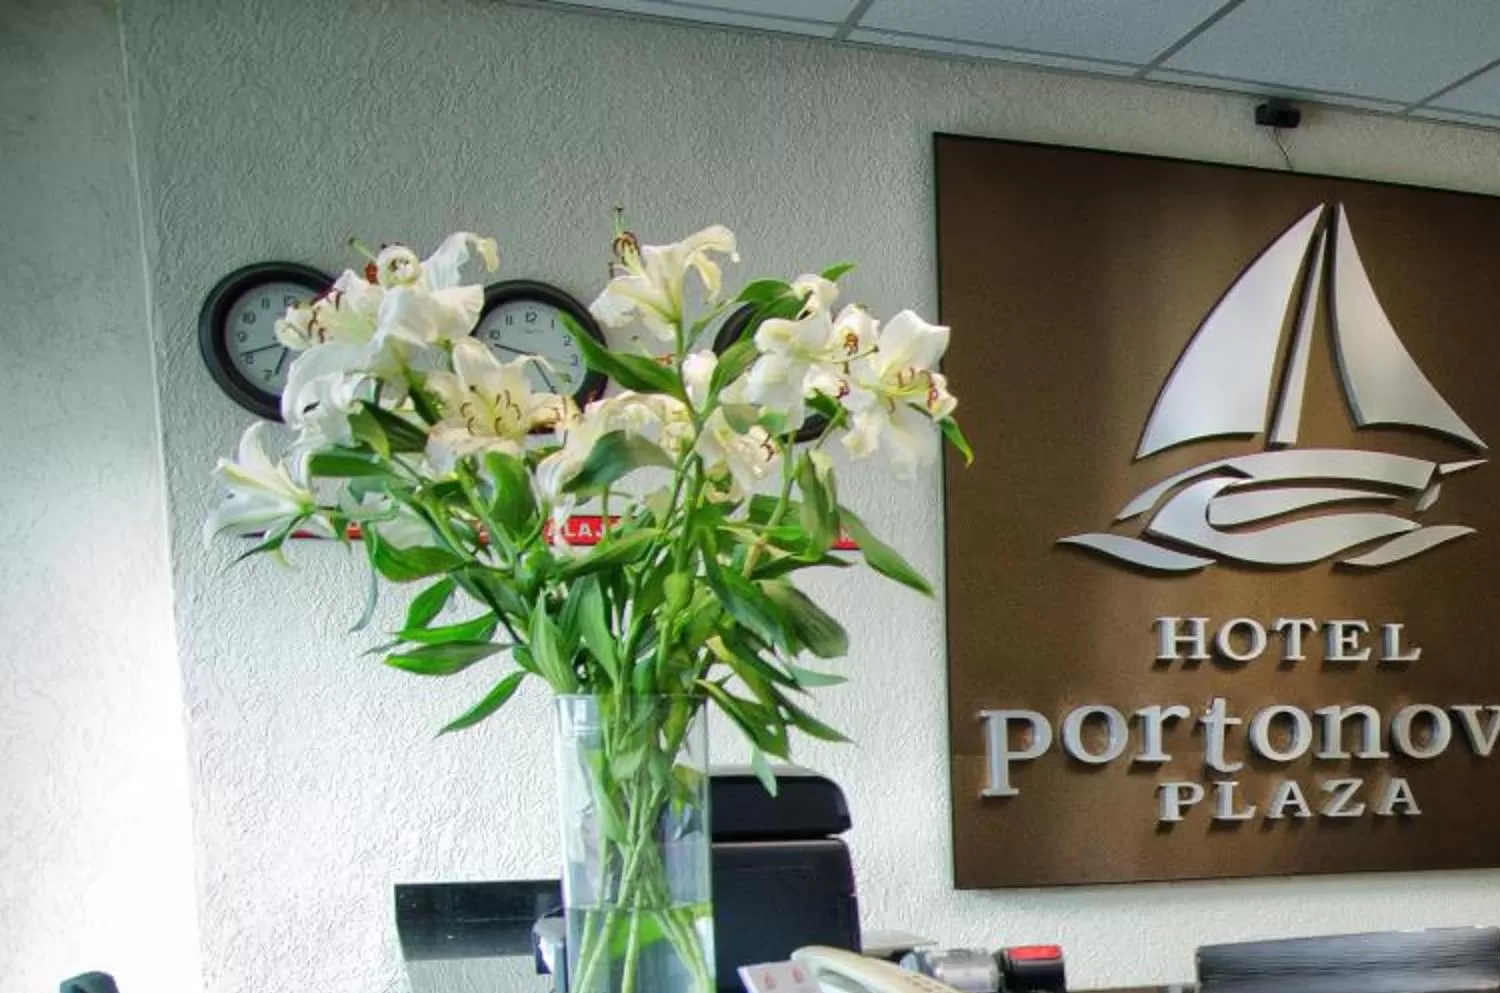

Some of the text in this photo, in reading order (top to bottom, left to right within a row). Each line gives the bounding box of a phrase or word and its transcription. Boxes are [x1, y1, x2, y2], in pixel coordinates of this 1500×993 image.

[505, 315, 513, 326] 11
[525, 311, 538, 323] 12
[563, 335, 572, 347] 2
[1154, 616, 1422, 661] HOTEL
[1158, 777, 1422, 822] PLAZA
